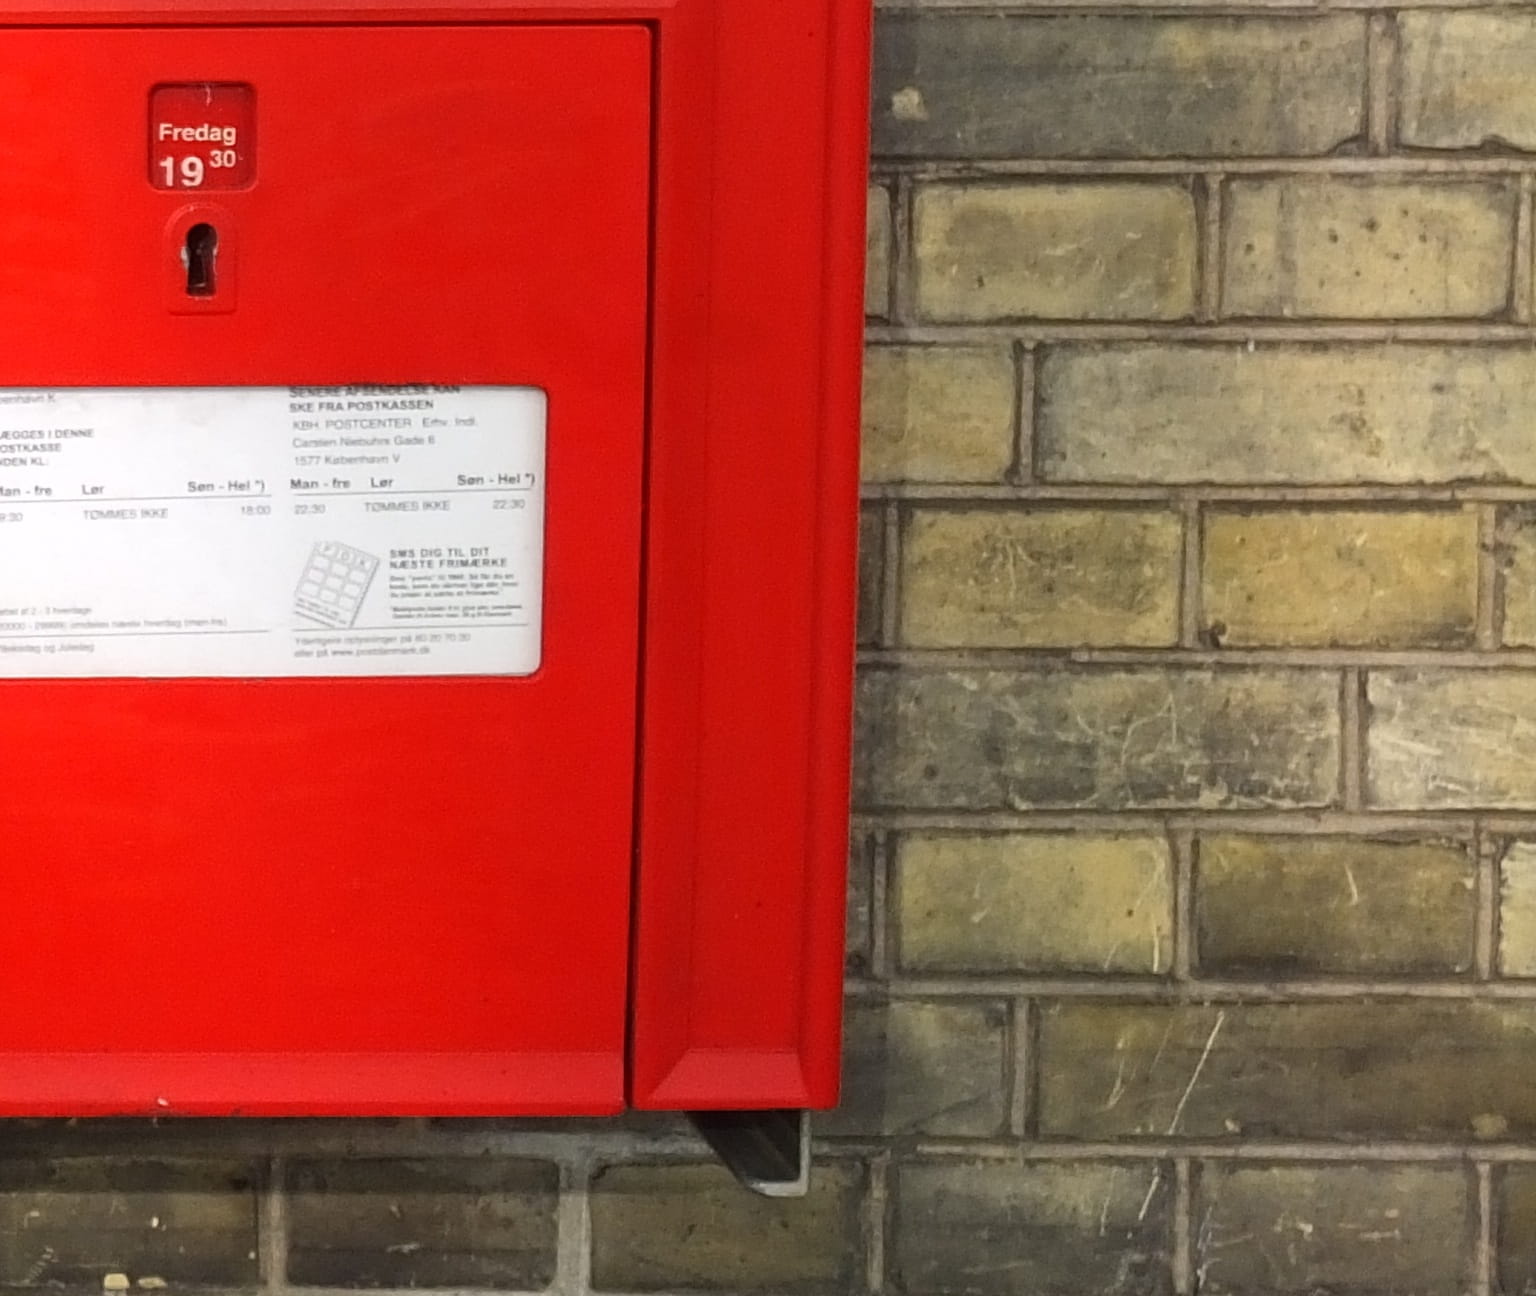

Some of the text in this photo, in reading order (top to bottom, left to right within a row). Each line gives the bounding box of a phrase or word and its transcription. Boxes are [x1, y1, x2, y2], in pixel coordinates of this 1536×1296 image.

[159, 123, 236, 146] Fredag
[159, 149, 236, 187] 19 30
[289, 399, 434, 413] SKE FRA POSTKASSEN
[54, 428, 95, 439] DENNE
[34, 485, 53, 496] fre
[81, 484, 105, 496] Lør
[187, 481, 215, 493] Søn
[228, 480, 251, 492] Hel
[290, 478, 319, 490] Man
[332, 477, 351, 489] fre
[370, 477, 394, 489] Lør
[456, 474, 484, 486] Søn
[497, 473, 521, 485] Hel
